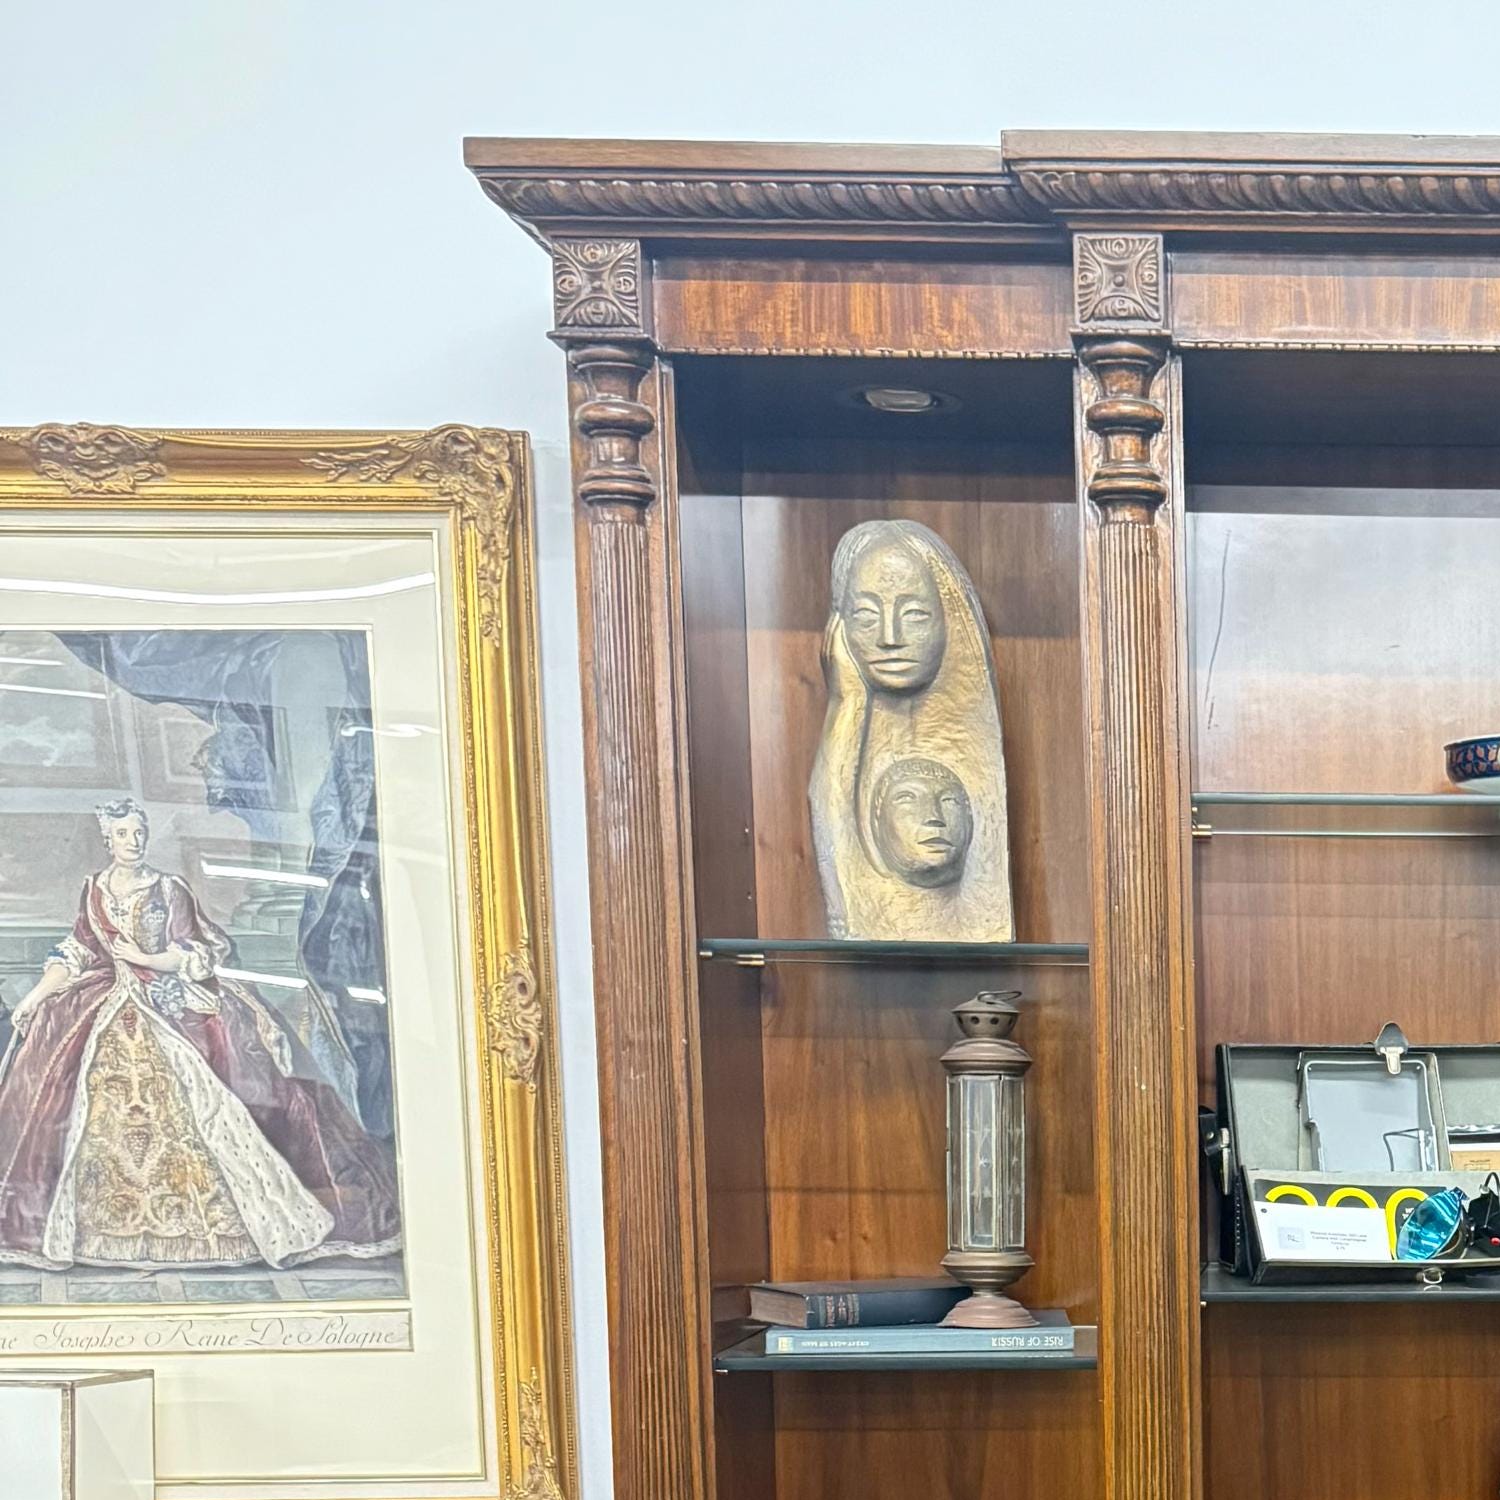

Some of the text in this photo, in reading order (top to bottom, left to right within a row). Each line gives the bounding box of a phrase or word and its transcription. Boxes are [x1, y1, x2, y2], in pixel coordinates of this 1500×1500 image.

[992, 1336, 1063, 1346] RISE OF RUSSIA
